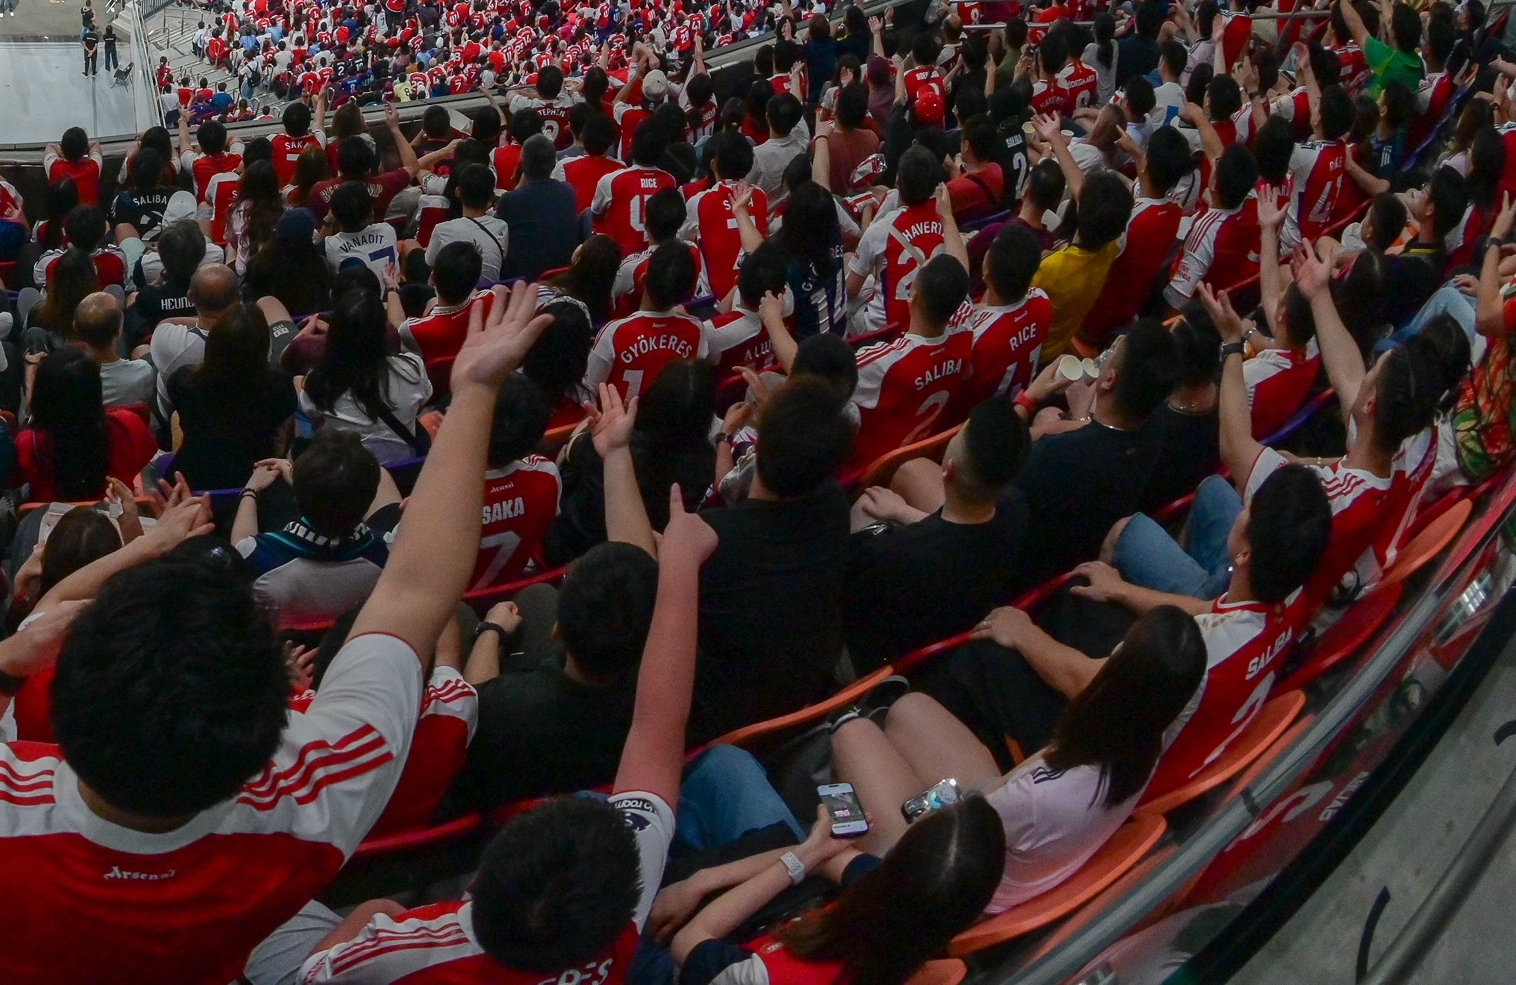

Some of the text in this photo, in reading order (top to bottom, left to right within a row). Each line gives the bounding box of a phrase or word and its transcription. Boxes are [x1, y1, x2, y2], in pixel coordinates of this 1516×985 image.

[640, 177, 658, 189] RICE
[132, 194, 168, 206] SALIBA
[902, 221, 946, 241] HAVERT
[339, 233, 385, 253] VANADIT
[1009, 322, 1037, 351] RICE
[621, 335, 693, 364] GYÖKERES
[915, 358, 963, 391] SALIBA
[490, 482, 515, 493] Arsenal
[482, 496, 525, 525] SAKA
[1245, 625, 1293, 680] SALIBA
[106, 865, 176, 881] Arsenal
